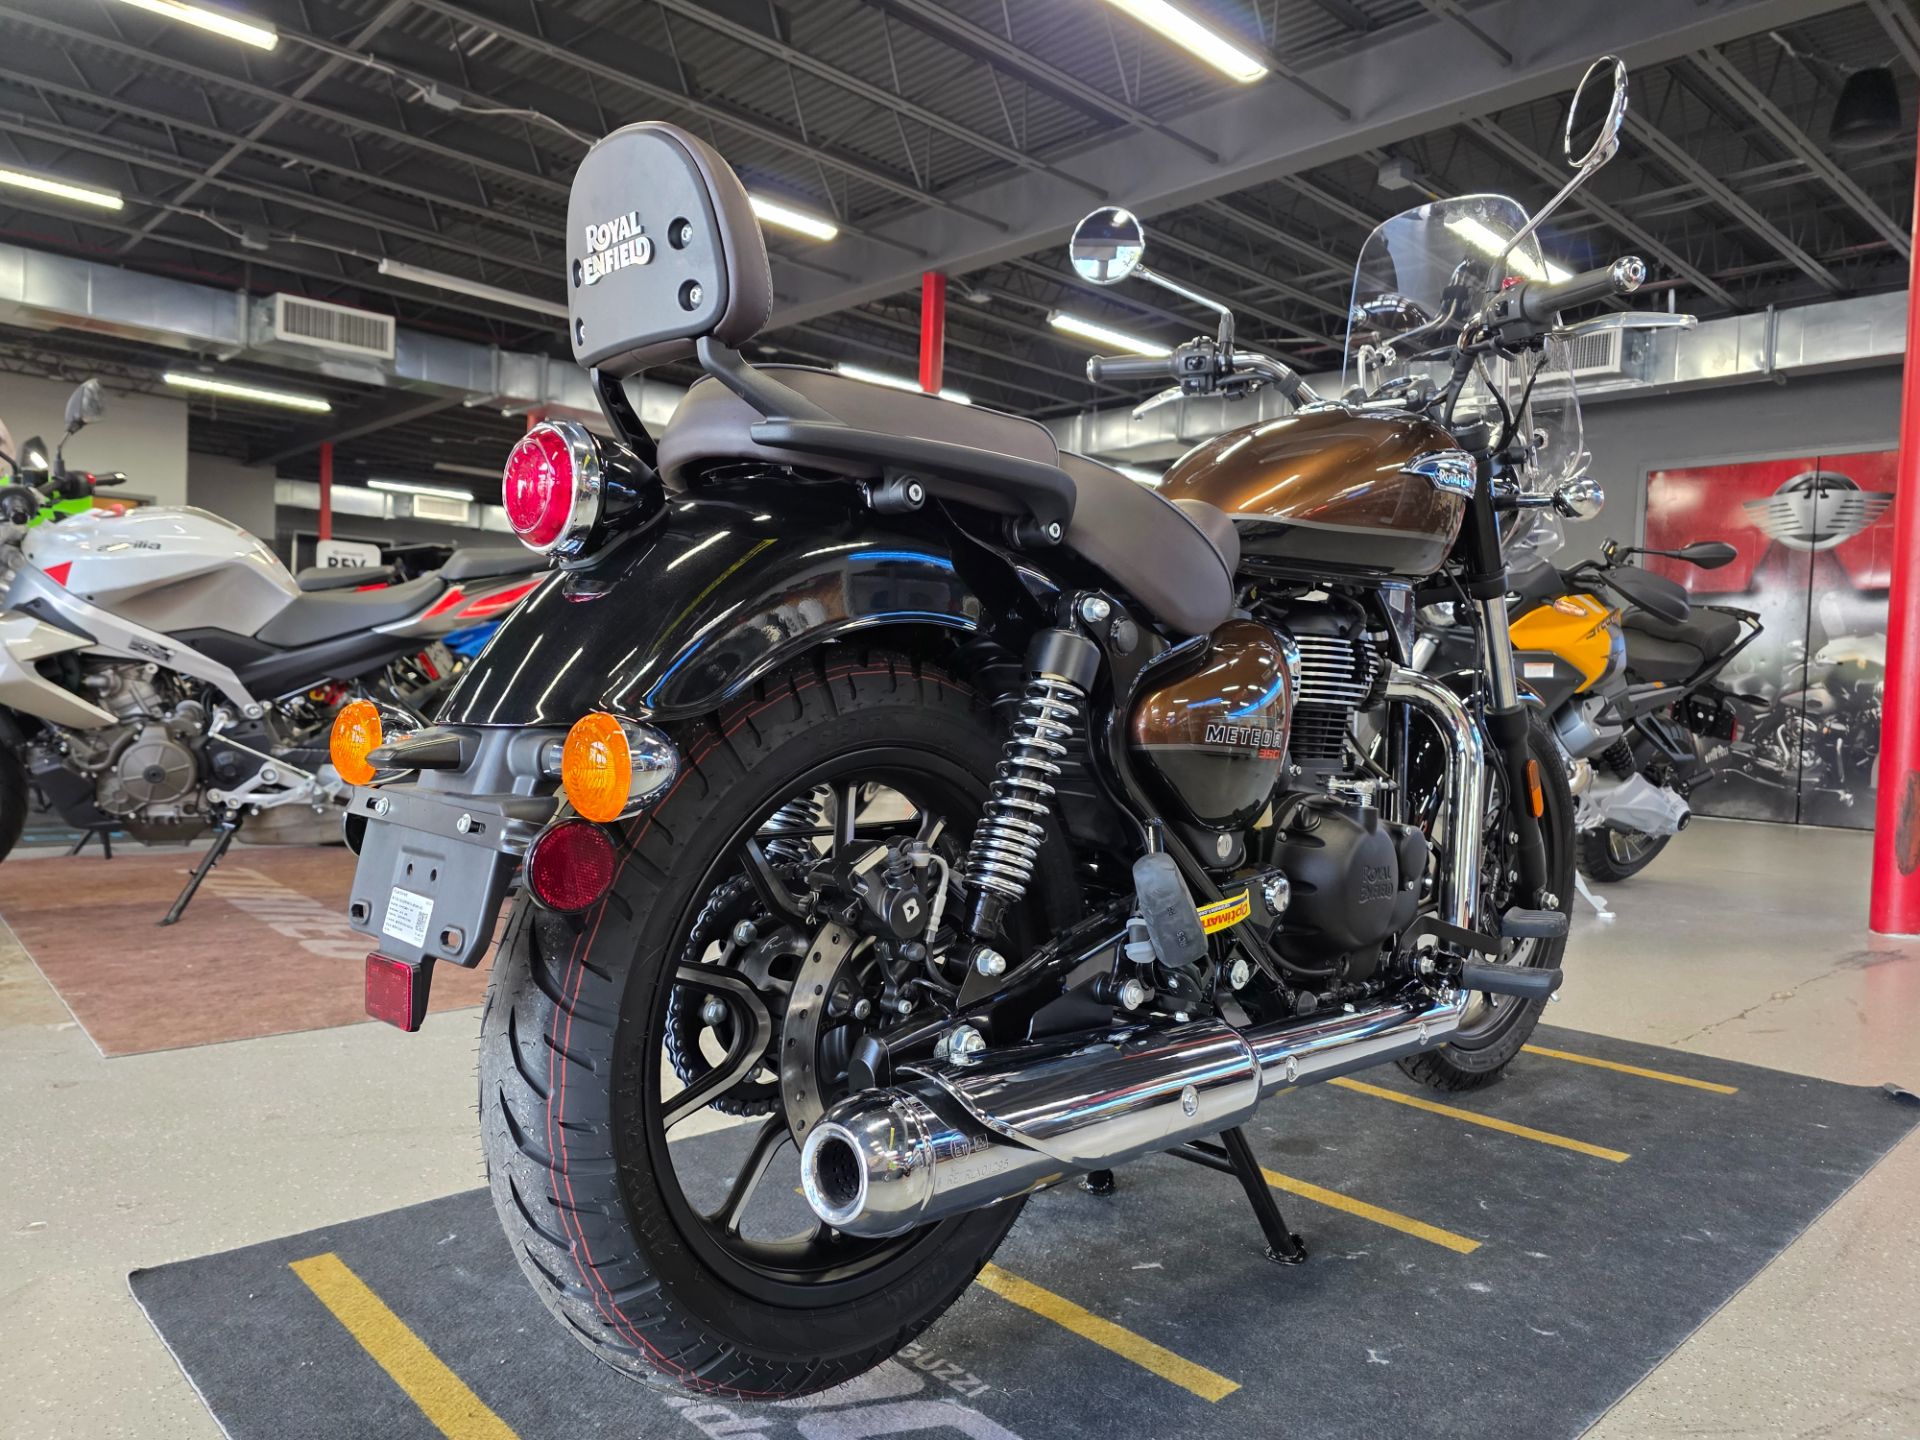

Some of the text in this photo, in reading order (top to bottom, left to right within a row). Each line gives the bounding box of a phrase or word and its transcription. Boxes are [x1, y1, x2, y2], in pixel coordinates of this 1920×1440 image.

[585, 211, 642, 254] ROYAL
[582, 236, 651, 285] ENFIELD
[1205, 724, 1283, 748] METEOR
[1258, 748, 1281, 759] 350
